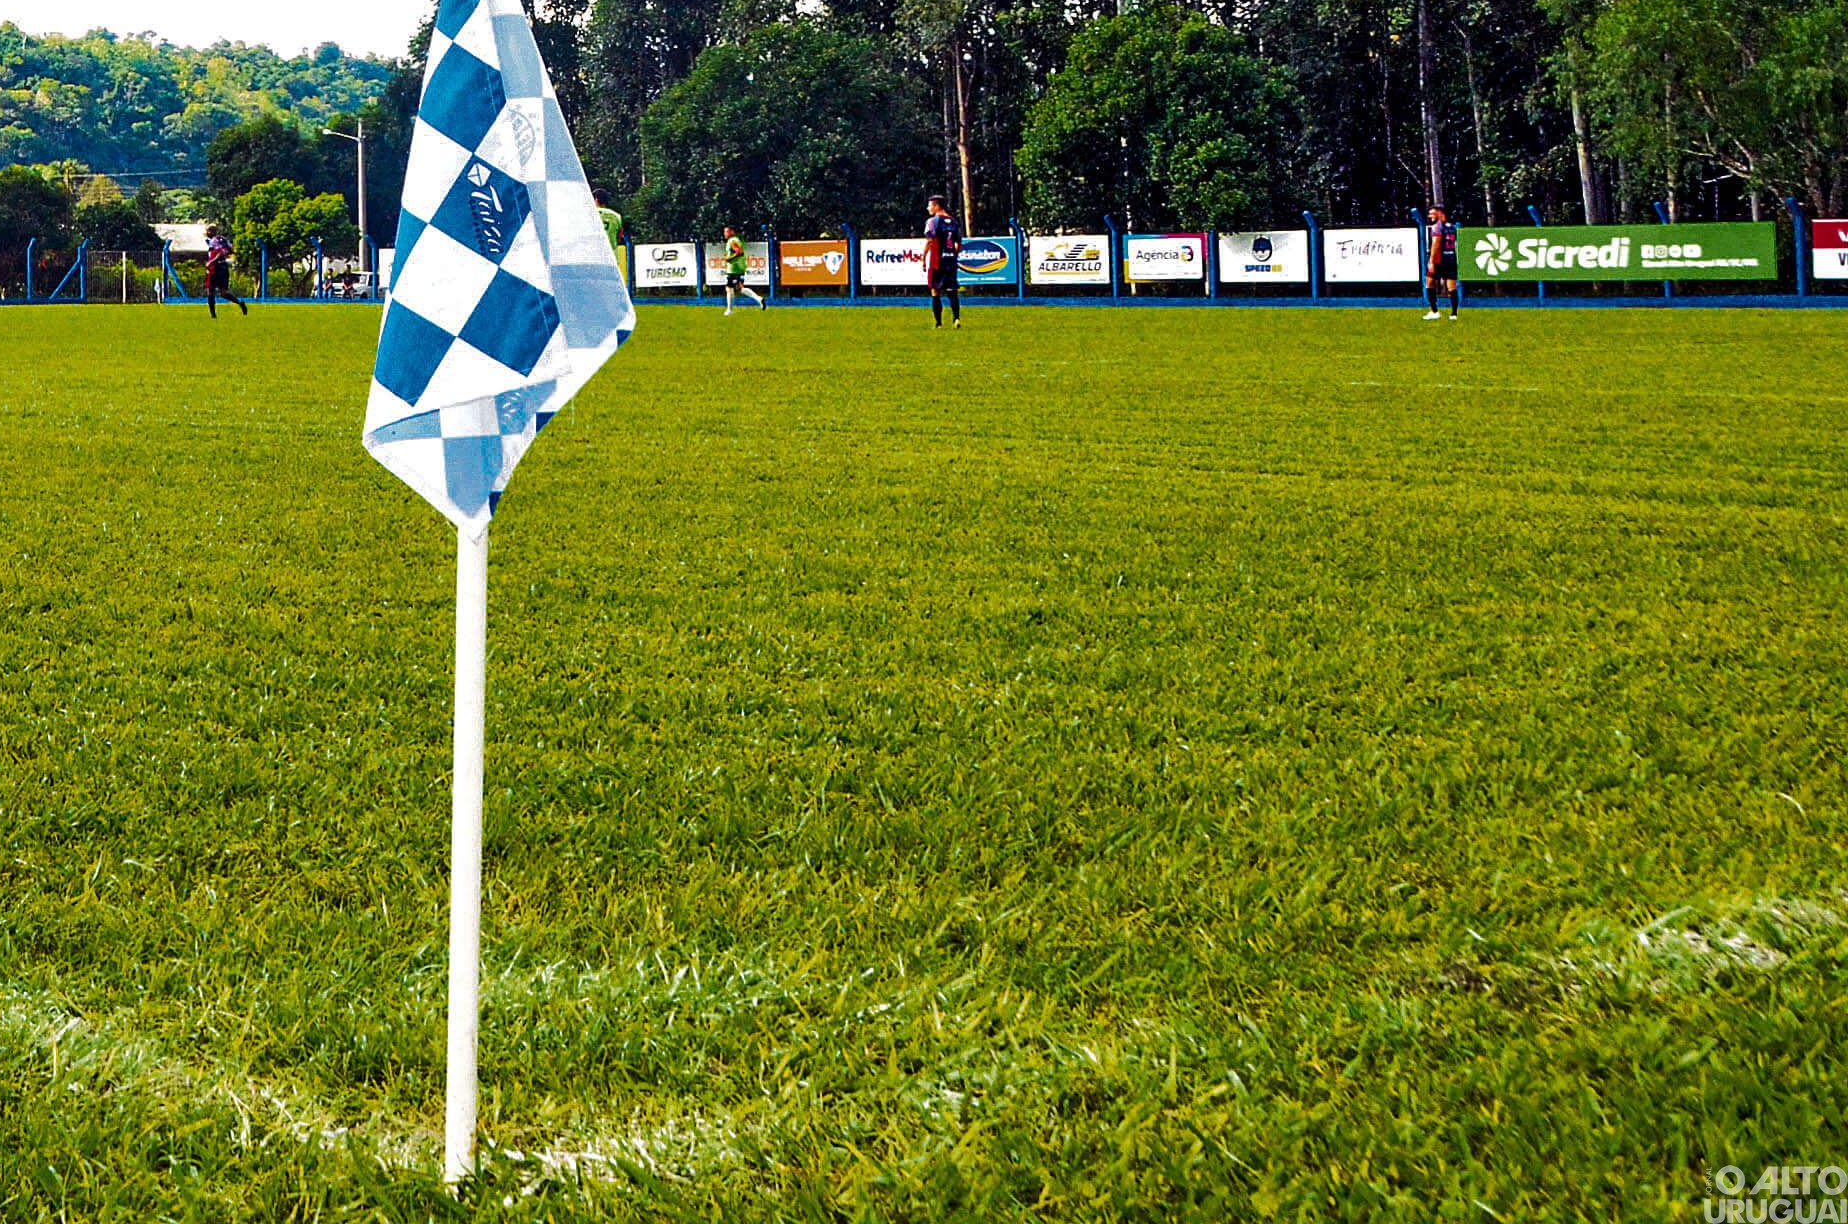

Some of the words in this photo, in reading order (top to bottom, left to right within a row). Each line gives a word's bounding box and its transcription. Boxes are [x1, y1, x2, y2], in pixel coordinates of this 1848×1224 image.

[1516, 237, 1631, 269] Sicredi
[646, 266, 687, 279] TURISMO
[1038, 261, 1102, 272] ALBARELLO
